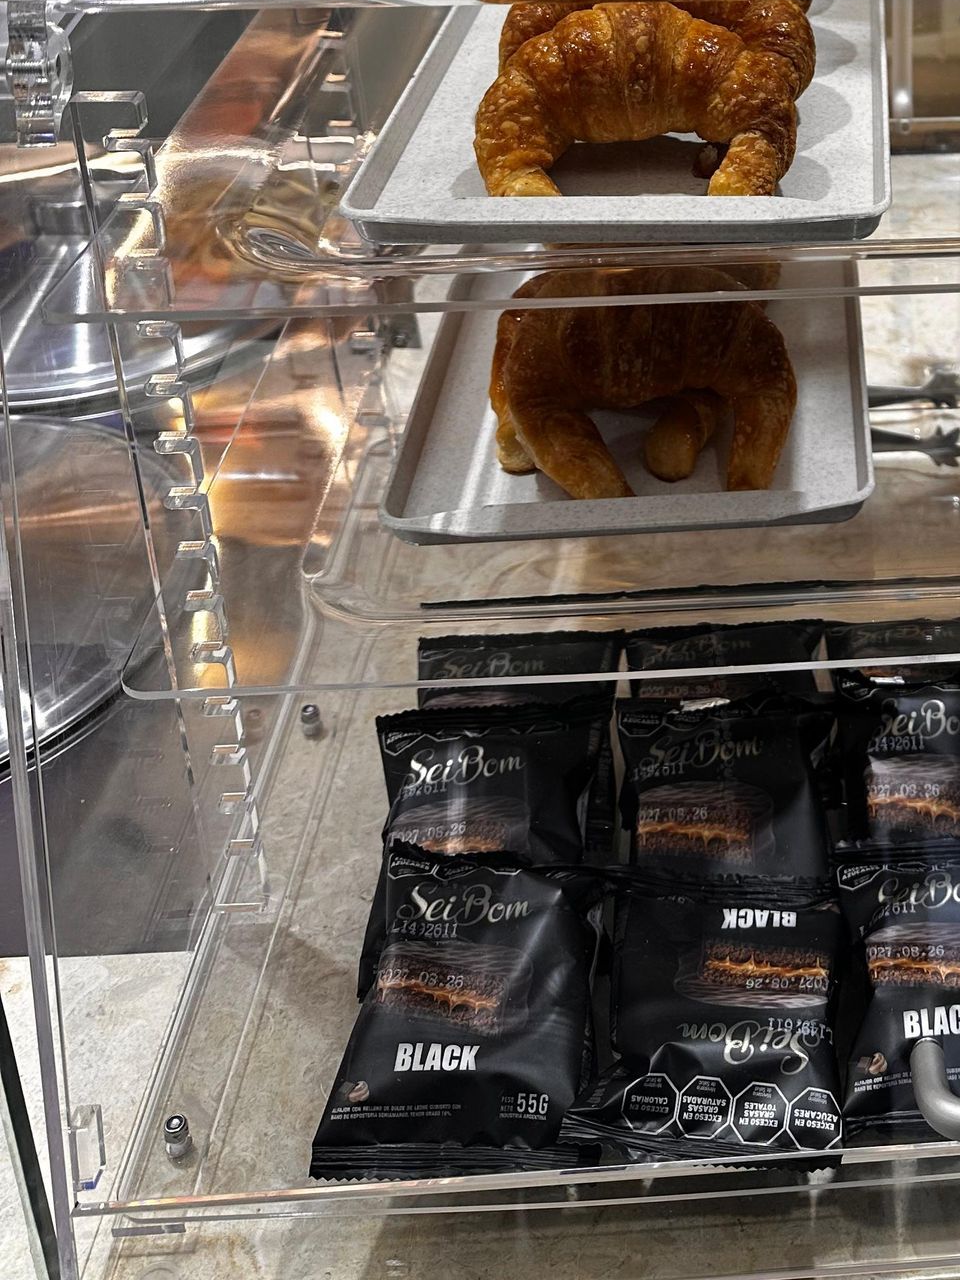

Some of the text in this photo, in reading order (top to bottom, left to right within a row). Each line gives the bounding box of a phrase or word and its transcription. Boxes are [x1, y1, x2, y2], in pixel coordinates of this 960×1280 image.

[721, 908, 797, 929] BLACK
[393, 1042, 481, 1072] BLACK
[517, 1092, 549, 1114] 55G
[682, 1095, 727, 1106] SATURADAS
[687, 1104, 719, 1114] GRASAS
[744, 1102, 777, 1111] TOTALES
[682, 1111, 722, 1123] EXCESO EN
[743, 1109, 775, 1119] GRASAS
[738, 1116, 778, 1127] EXCESO EN
[794, 1118, 835, 1130] EXCESO EN
